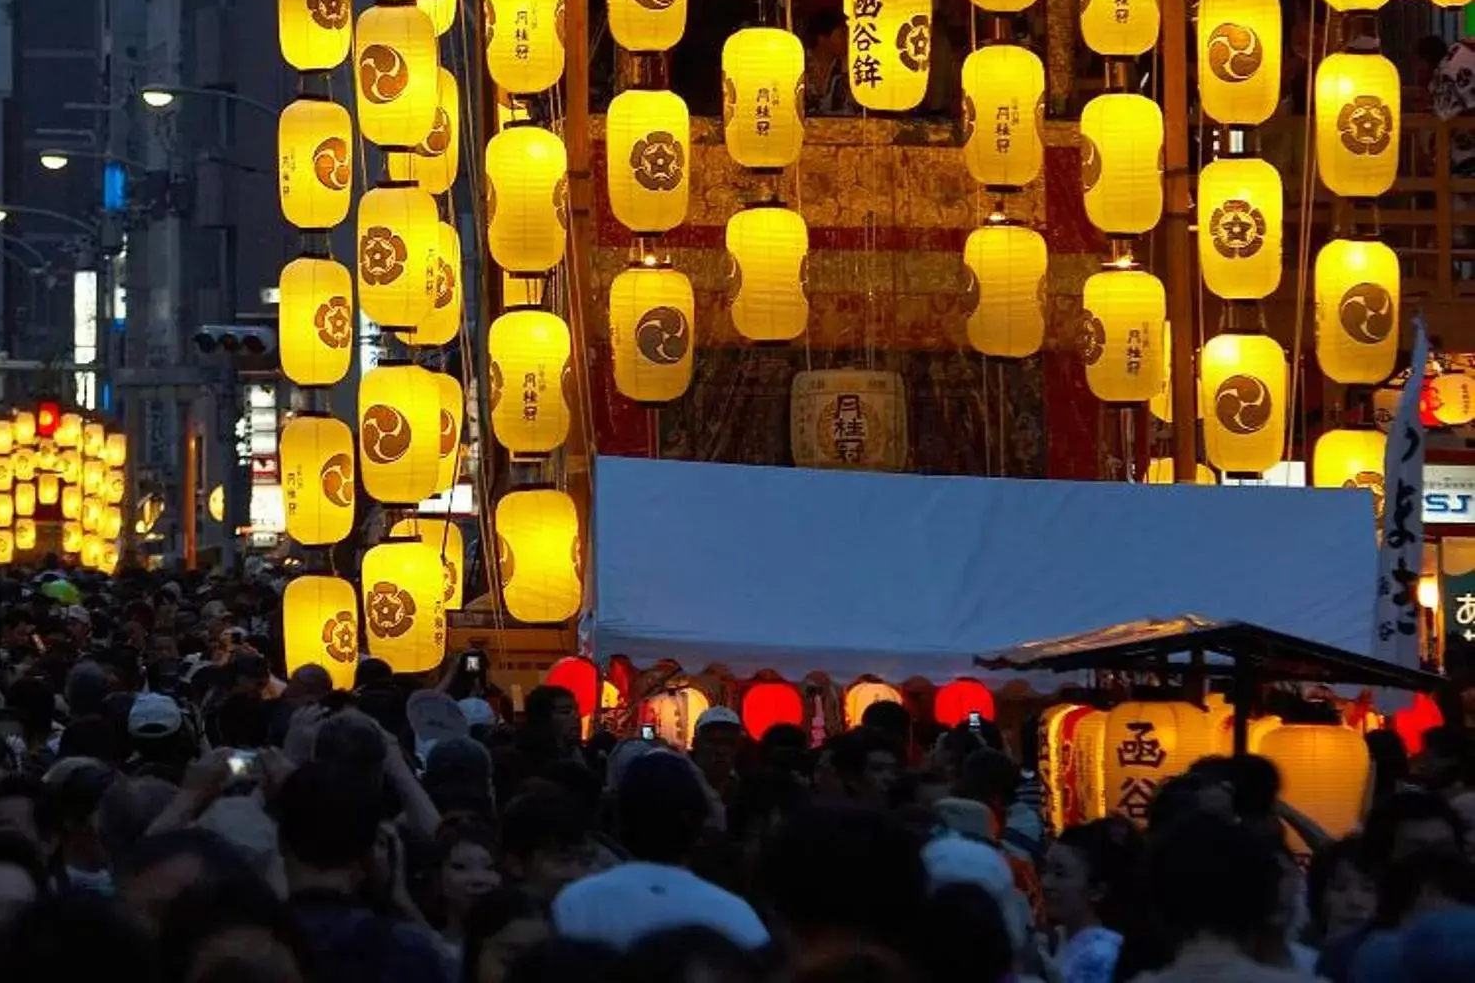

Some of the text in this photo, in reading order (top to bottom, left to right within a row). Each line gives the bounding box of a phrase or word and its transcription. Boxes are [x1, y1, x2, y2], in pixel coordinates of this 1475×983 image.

[755, 87, 771, 137] 月桂冠
[995, 106, 1010, 154] 月桂冠
[1127, 329, 1142, 376] 月桂冠
[522, 372, 538, 422] 月桂冠
[833, 394, 865, 464] 月桂冠
